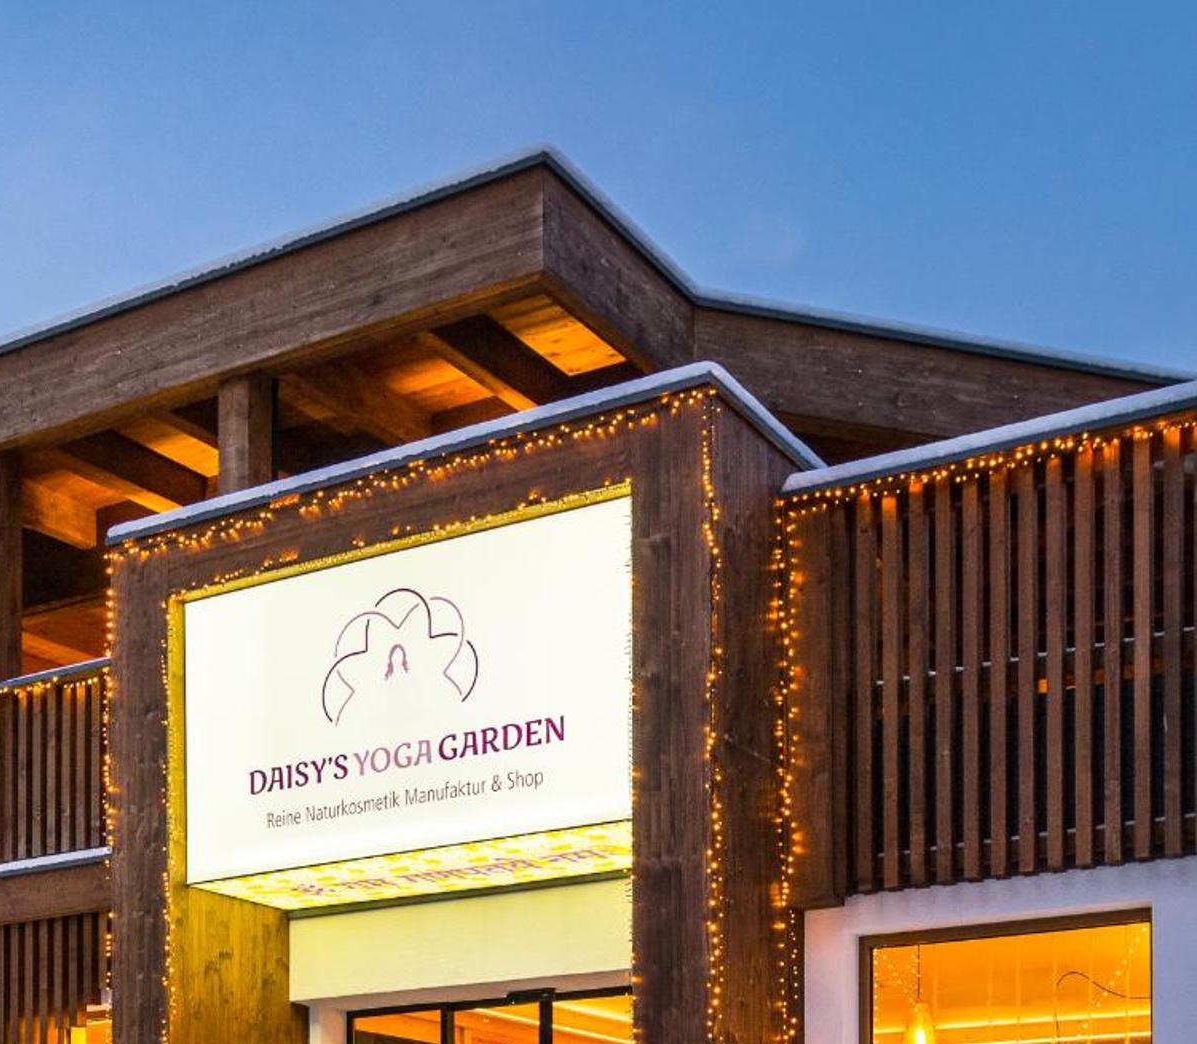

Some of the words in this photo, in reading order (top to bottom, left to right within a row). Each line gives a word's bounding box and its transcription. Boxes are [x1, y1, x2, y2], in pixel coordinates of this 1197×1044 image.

[249, 754, 349, 796] DAISY'S
[354, 739, 432, 776] YOGA
[438, 715, 565, 761] GARDEN
[266, 810, 302, 829] Reine
[306, 791, 401, 822] Naturkosmetik
[405, 779, 486, 805] Manufaktur
[491, 774, 502, 792] &
[507, 769, 544, 790] Shop
